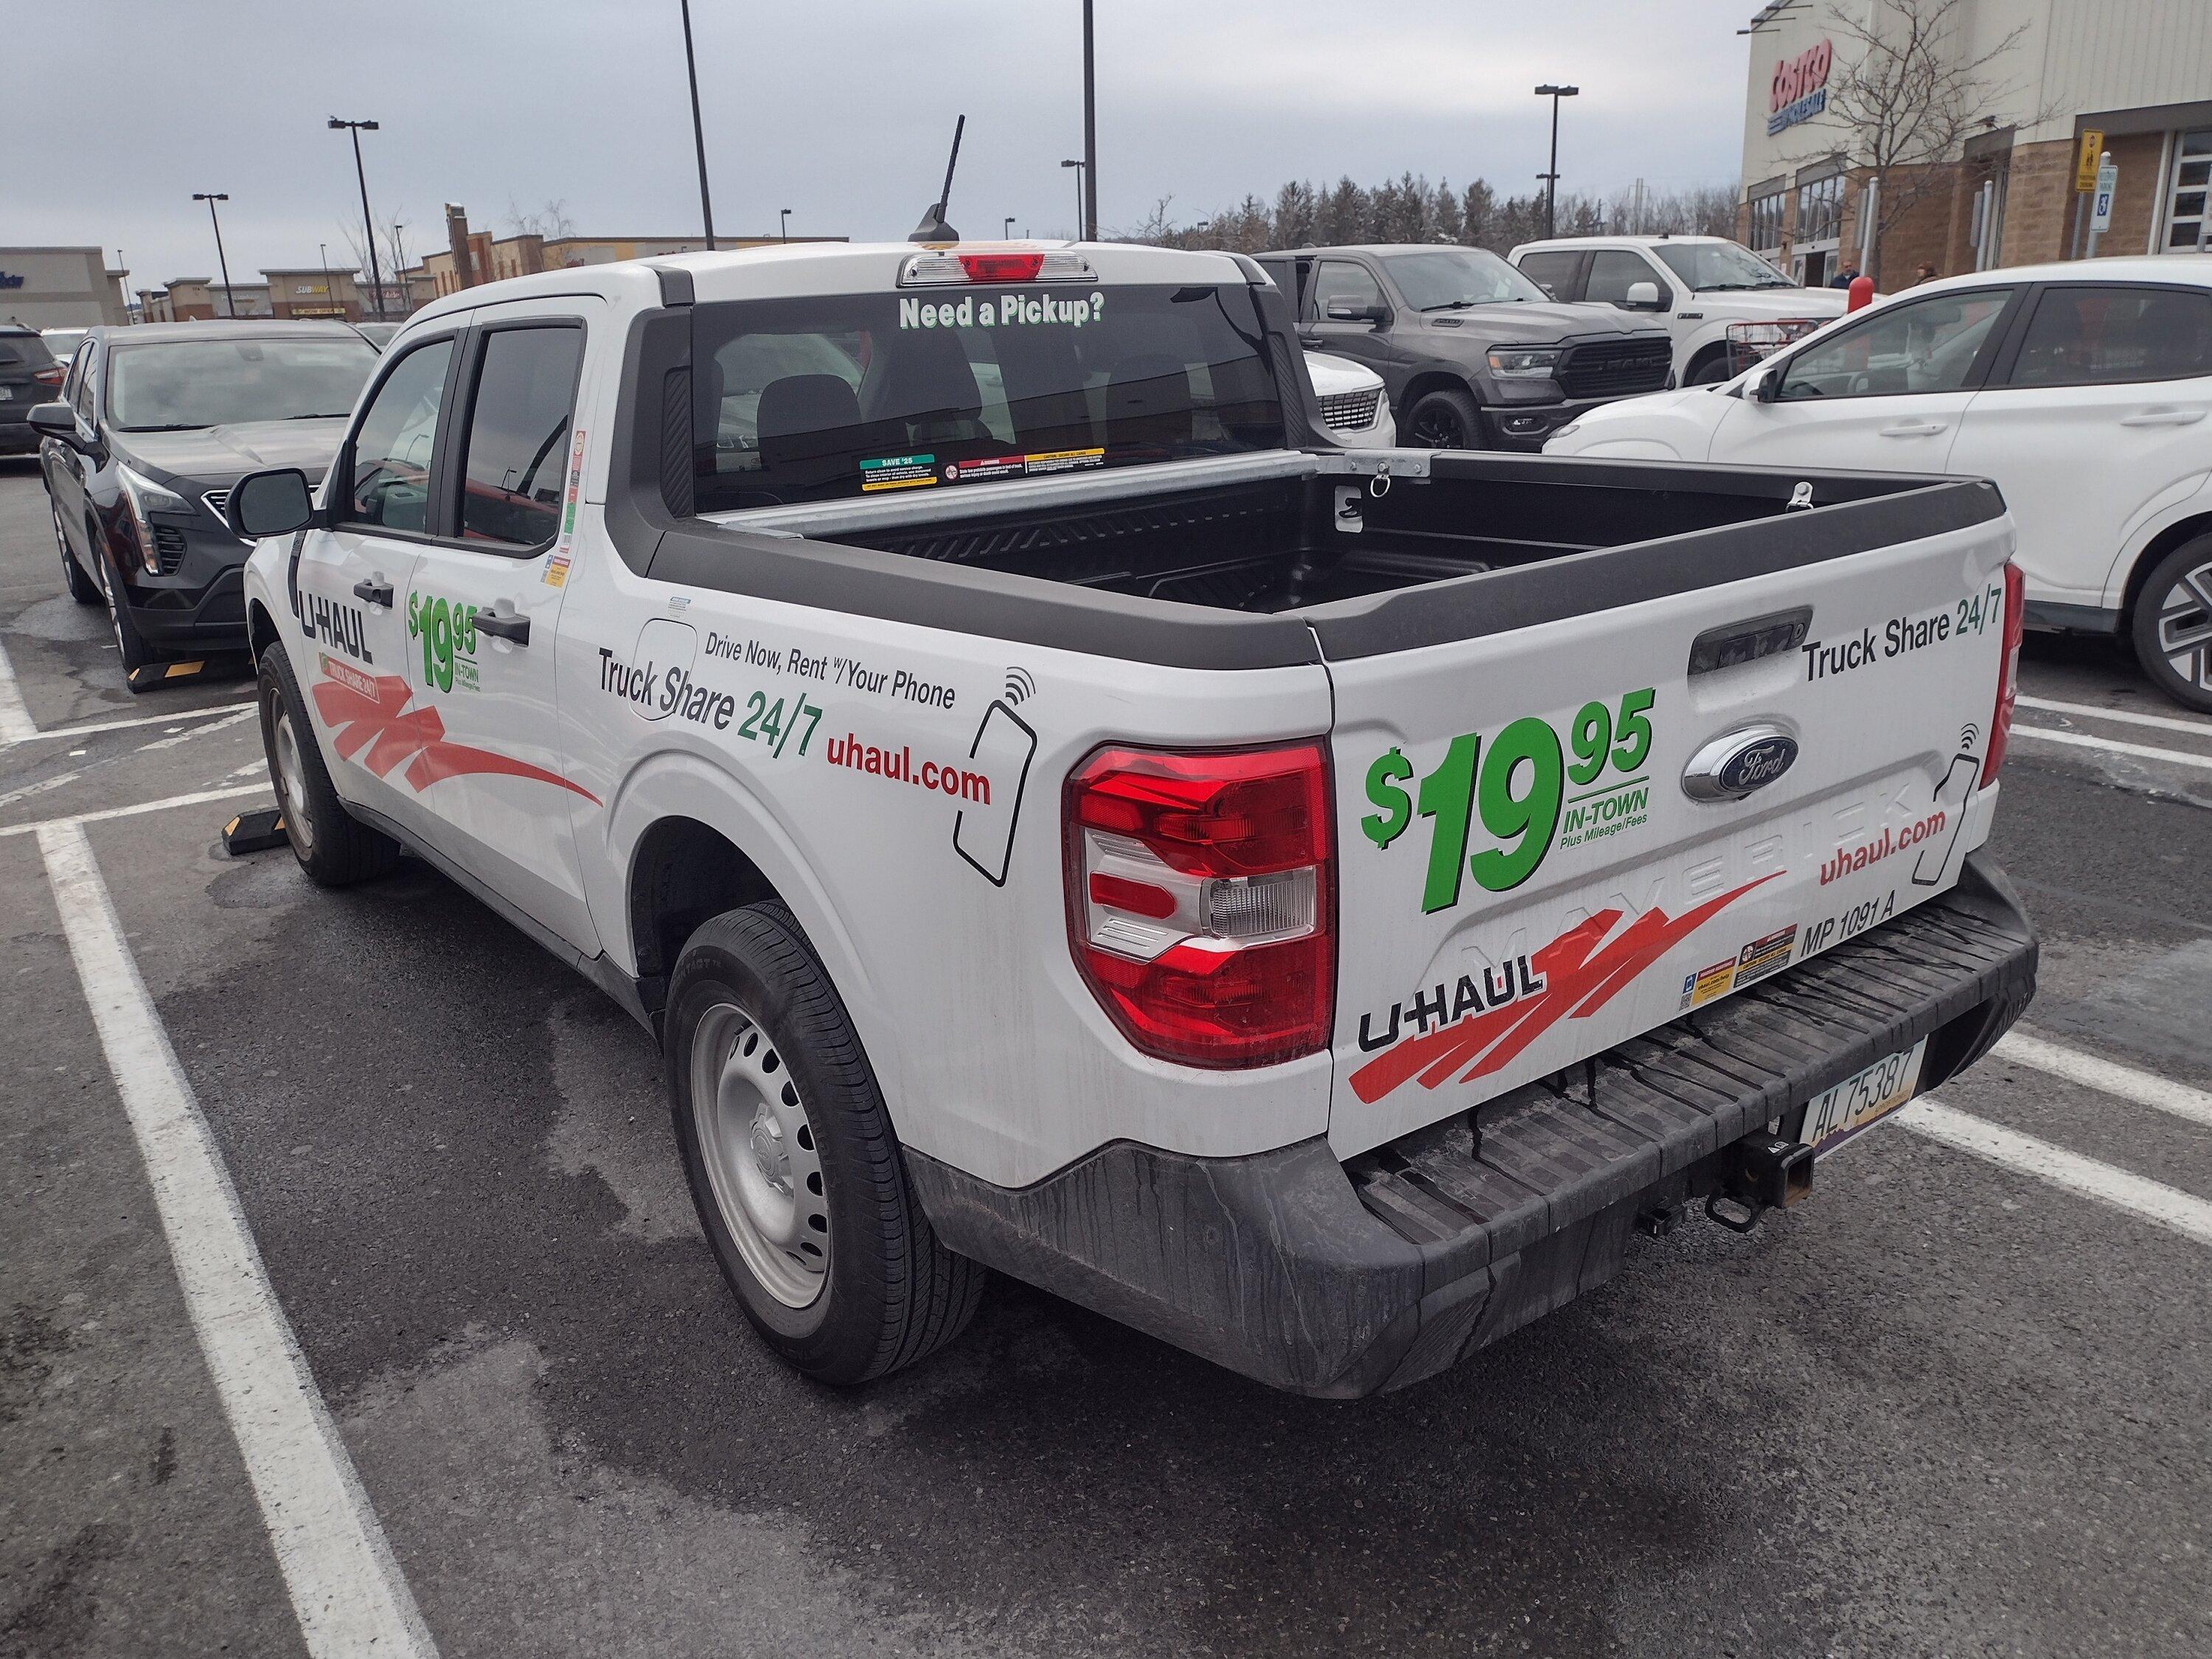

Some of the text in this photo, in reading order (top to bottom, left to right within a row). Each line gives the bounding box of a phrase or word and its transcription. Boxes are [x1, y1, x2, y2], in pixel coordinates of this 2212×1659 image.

[1769, 38, 1832, 113] COSTCO
[296, 285, 328, 293] SUBWAY
[900, 292, 1105, 329] Need a Pickup?
[882, 458, 900, 466] SAVE
[299, 590, 373, 665] U-HAUL
[1802, 583, 2002, 681] Truck Share 24/7
[599, 647, 824, 759] Truck Share 24/7
[705, 631, 742, 662] Drive
[745, 639, 782, 675] Now,
[787, 648, 828, 682] Rent
[891, 670, 956, 709] Phone
[827, 733, 992, 807] uhaul.com
[1739, 746, 1787, 785] Ford
[1559, 813, 1648, 850] Plus Mileage/Fees
[1562, 787, 1649, 834] IN-TOWN
[1820, 810, 1946, 886] uhaul.com
[1801, 917, 1835, 958] MP
[1840, 902, 1879, 940] 1091
[1882, 889, 1896, 917] A
[1357, 956, 1543, 1053] U-HAUL
